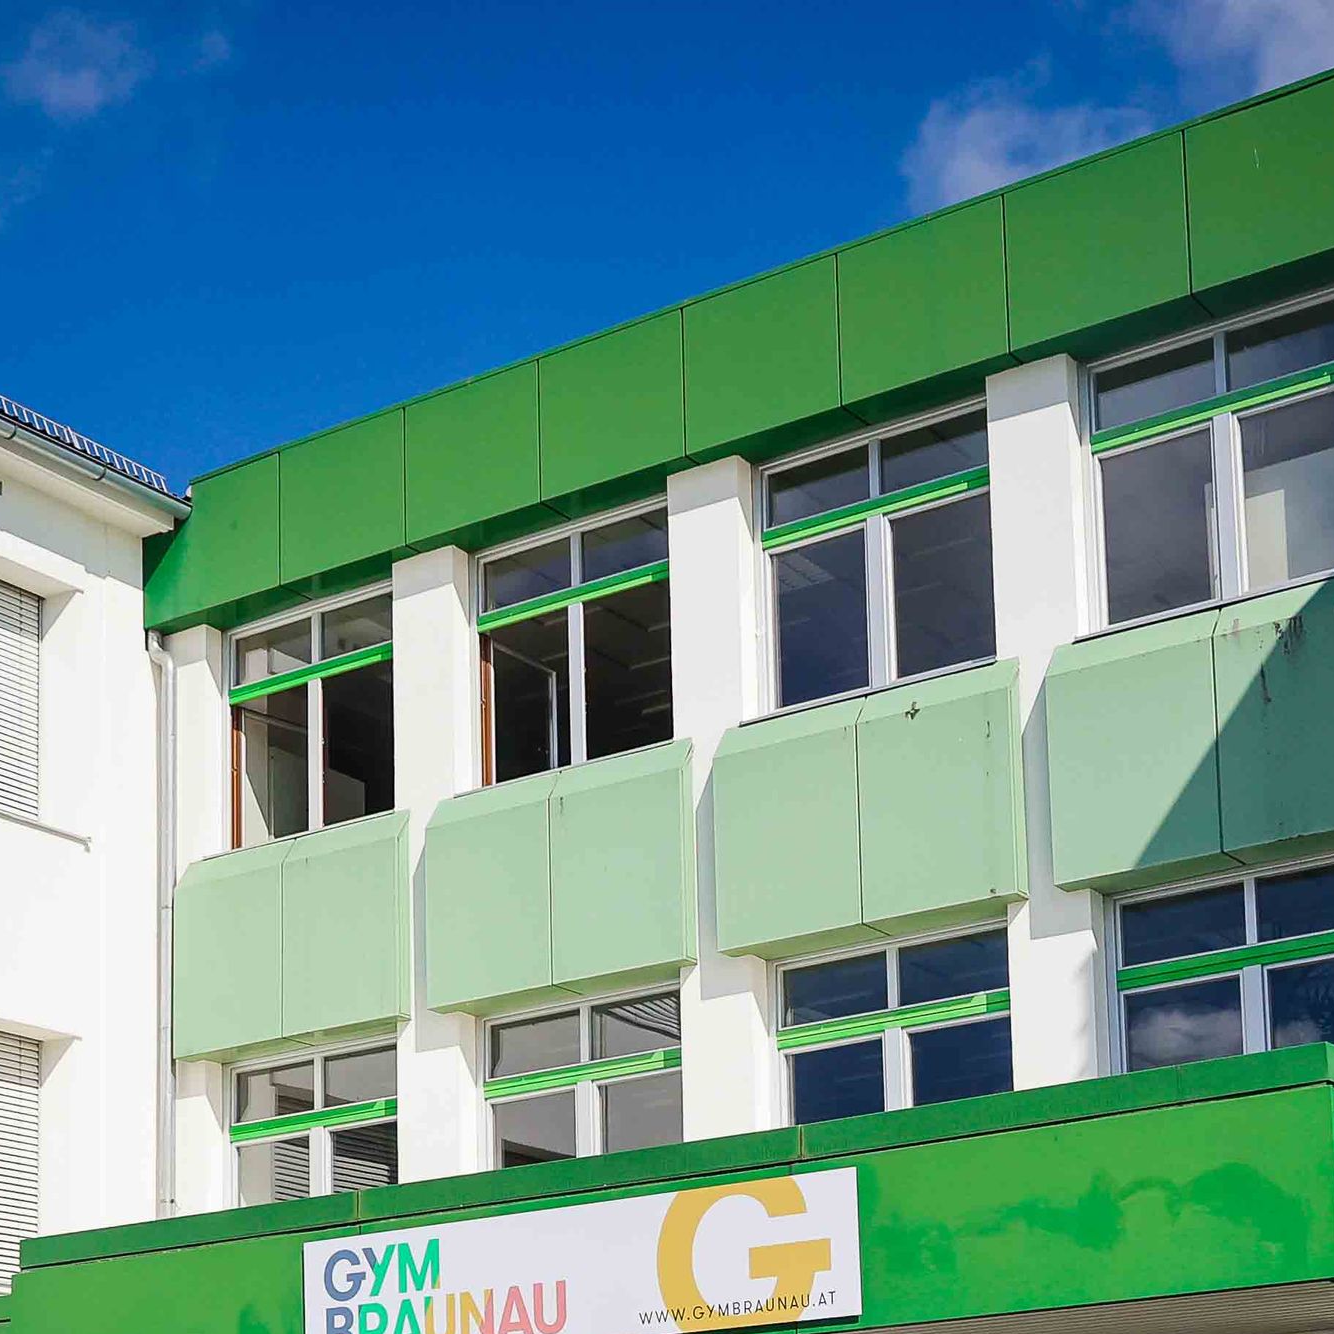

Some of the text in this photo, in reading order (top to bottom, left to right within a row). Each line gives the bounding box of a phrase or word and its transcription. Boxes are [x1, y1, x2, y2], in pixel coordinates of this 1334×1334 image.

[323, 1238, 441, 1302] GYM
[656, 1176, 832, 1334] G
[639, 1290, 837, 1326] WWW.GYMBRAUNAU.AT
